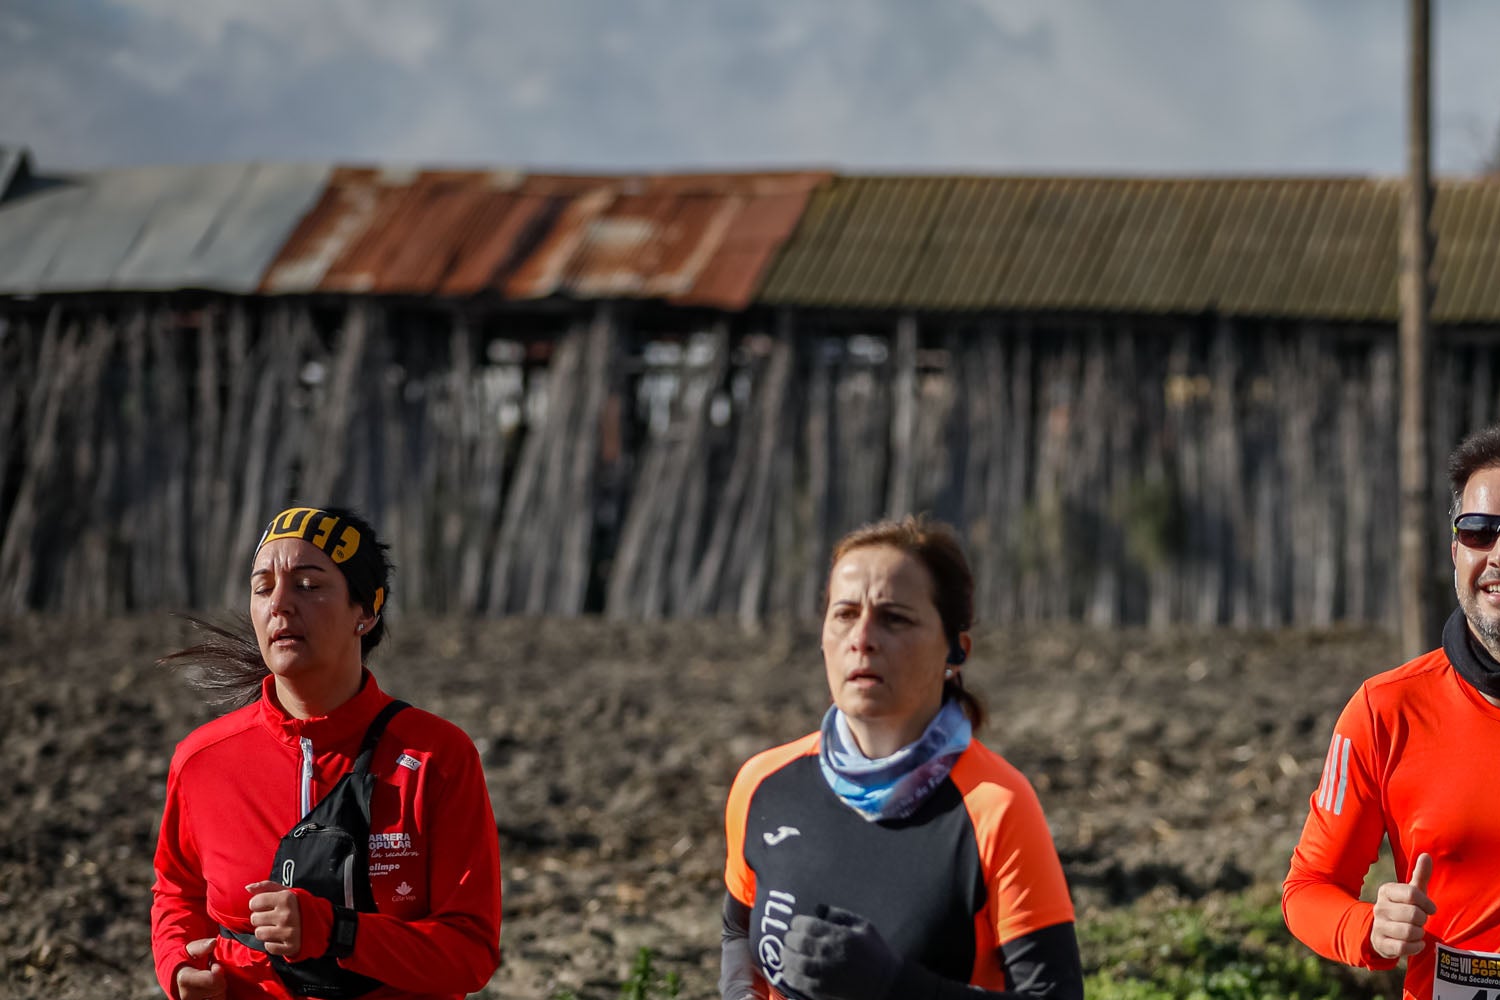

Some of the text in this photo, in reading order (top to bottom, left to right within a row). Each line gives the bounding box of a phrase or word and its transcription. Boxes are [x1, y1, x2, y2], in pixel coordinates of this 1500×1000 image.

[368, 833, 411, 841] ARRERA
[368, 841, 412, 849] OPULAR
[369, 863, 400, 872] olimpo
[1441, 953, 1451, 965] 26
[1460, 957, 1471, 974] VII
